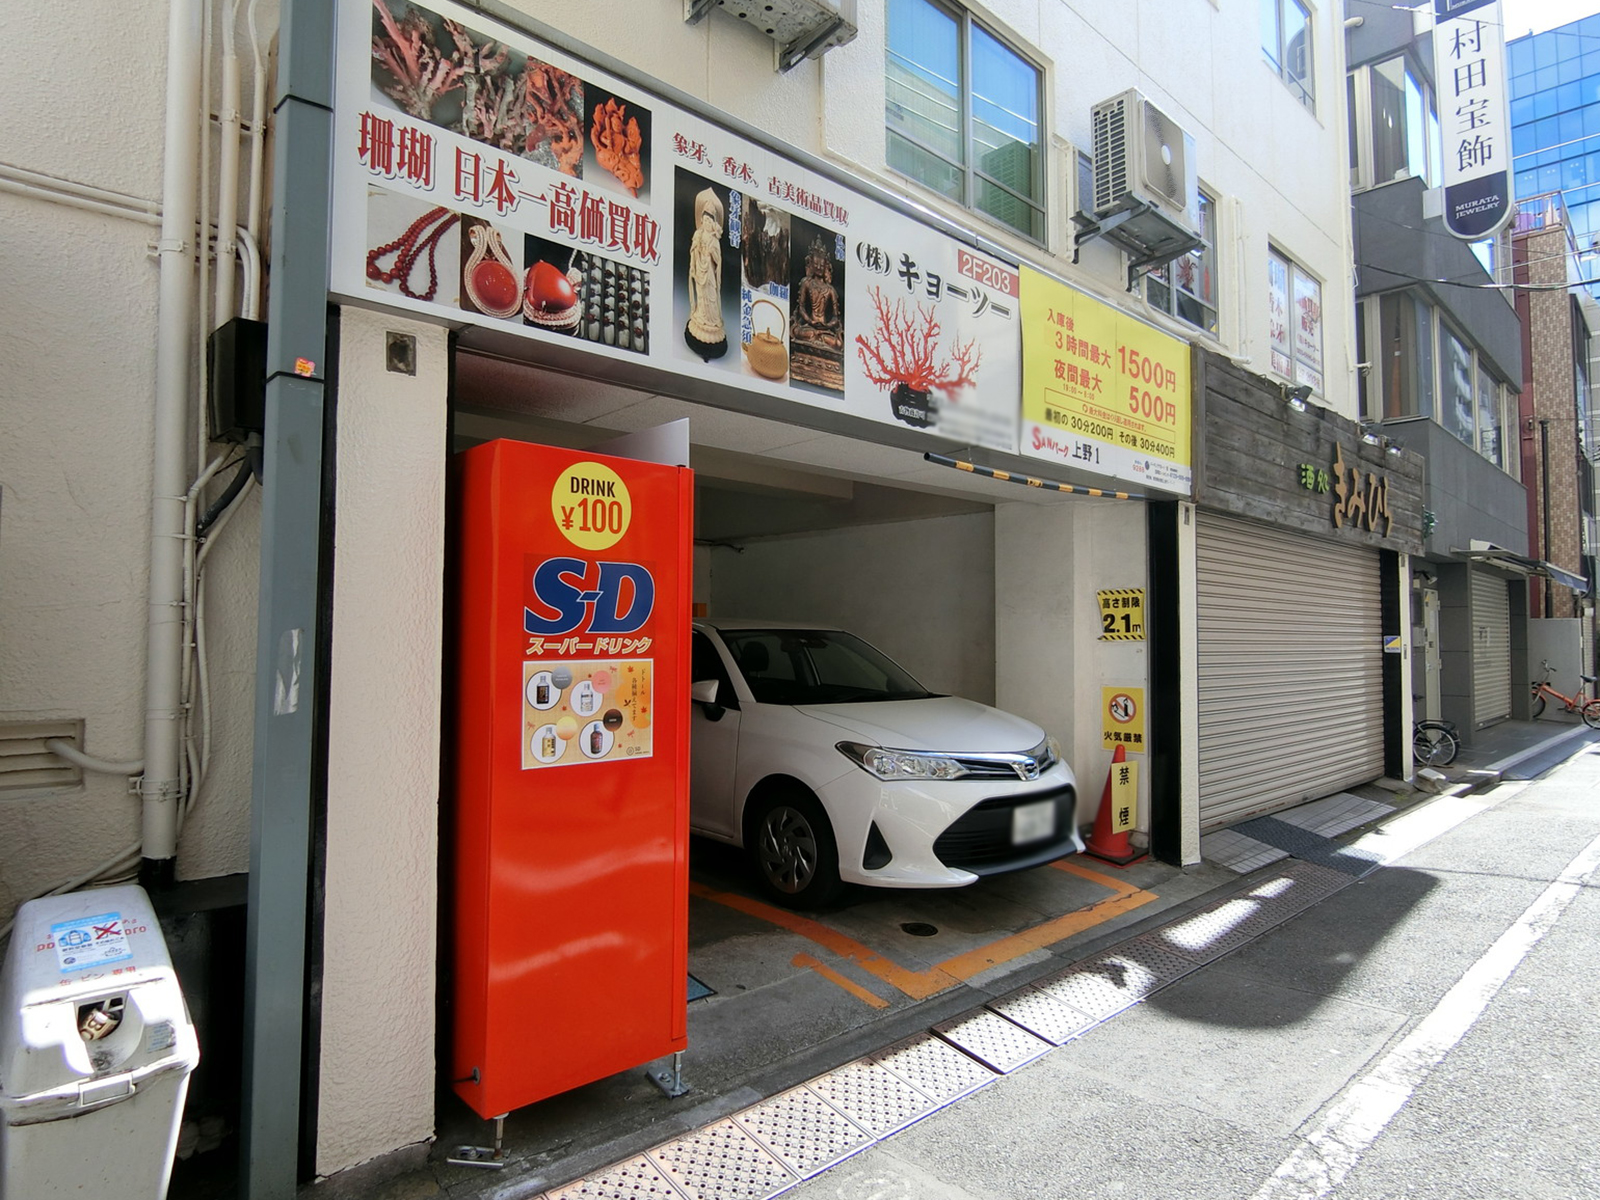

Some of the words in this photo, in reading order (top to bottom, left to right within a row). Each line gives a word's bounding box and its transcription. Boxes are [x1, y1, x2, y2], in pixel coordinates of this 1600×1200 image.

[1450, 20, 1493, 172] 村田宝飾
[357, 111, 435, 188] 珊瑚
[453, 146, 660, 261] 日本一高価買取
[1455, 195, 1499, 211] MURATA
[1455, 201, 1500, 219] JEWELRY
[962, 254, 1010, 293] 2F203
[1047, 308, 1074, 332] 入庫後
[1055, 331, 1111, 369] 3時間最大
[1118, 346, 1176, 393] 1500円
[1054, 359, 1102, 393] 夜間最大
[1129, 386, 1176, 426] 500円
[1071, 416, 1113, 440] 30分200円
[1119, 431, 1137, 447] その後
[1140, 438, 1175, 458] 30分400円
[570, 476, 616, 498] DRINK
[561, 497, 623, 534] ¥100
[1102, 597, 1140, 608] 高さ制限
[1103, 613, 1141, 633] 2.1m
[526, 636, 652, 655] スーパードリンク
[1104, 731, 1142, 743] 火気厳禁
[1119, 766, 1130, 827] 禁煙
